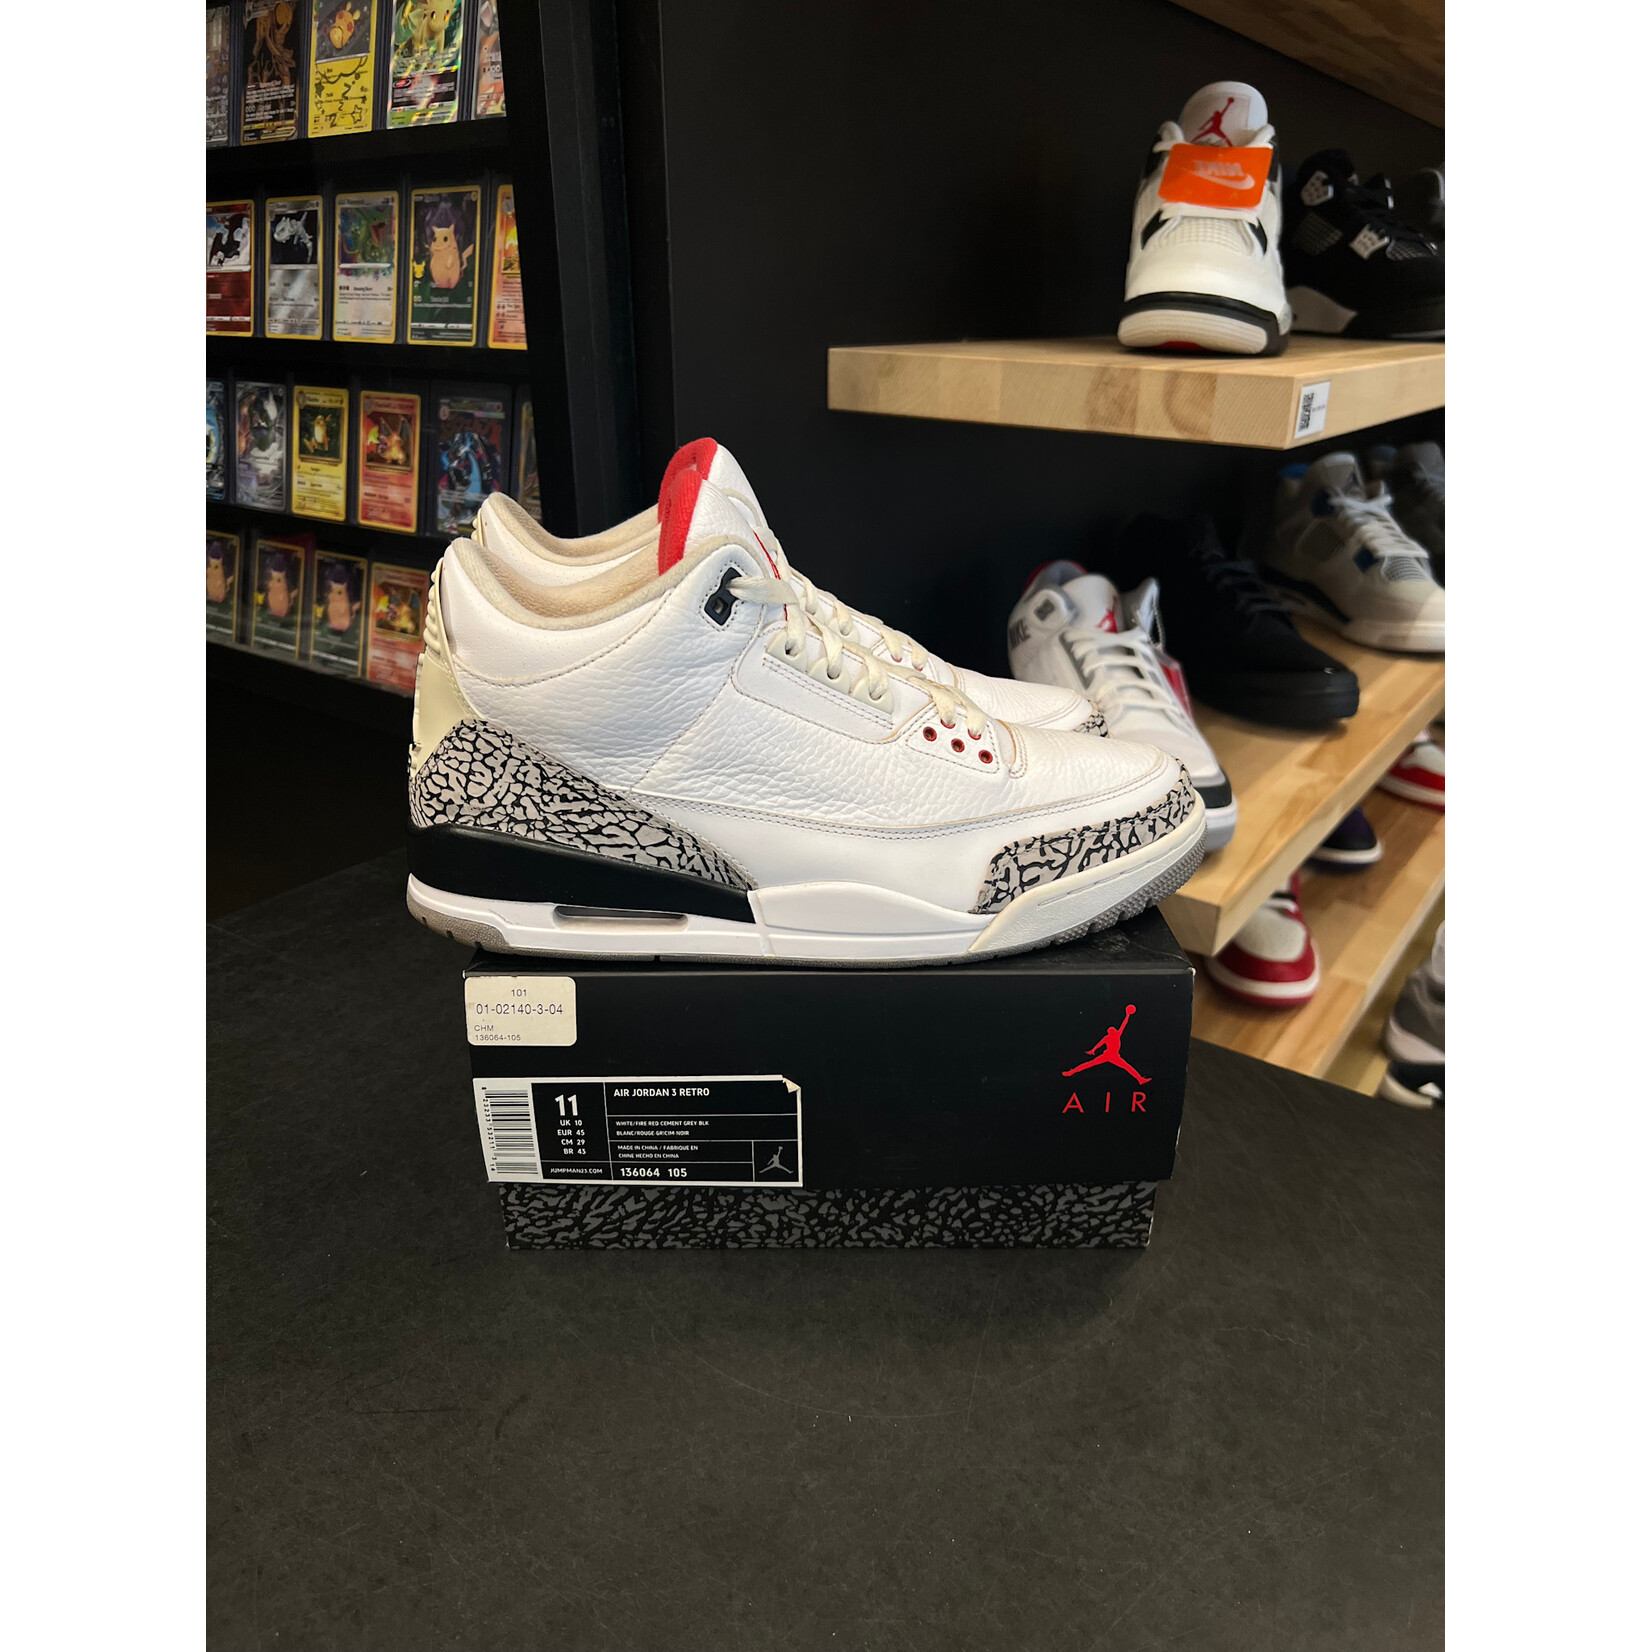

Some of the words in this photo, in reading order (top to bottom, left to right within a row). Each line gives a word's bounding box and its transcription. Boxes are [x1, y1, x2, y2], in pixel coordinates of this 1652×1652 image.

[477, 1004, 562, 1014] 01-02140-3-04
[632, 1088, 669, 1096] JORDAN
[679, 1088, 709, 1096] RETRO
[555, 1095, 578, 1116] 11
[621, 1168, 660, 1177] 136064
[668, 1168, 687, 1177] 105
